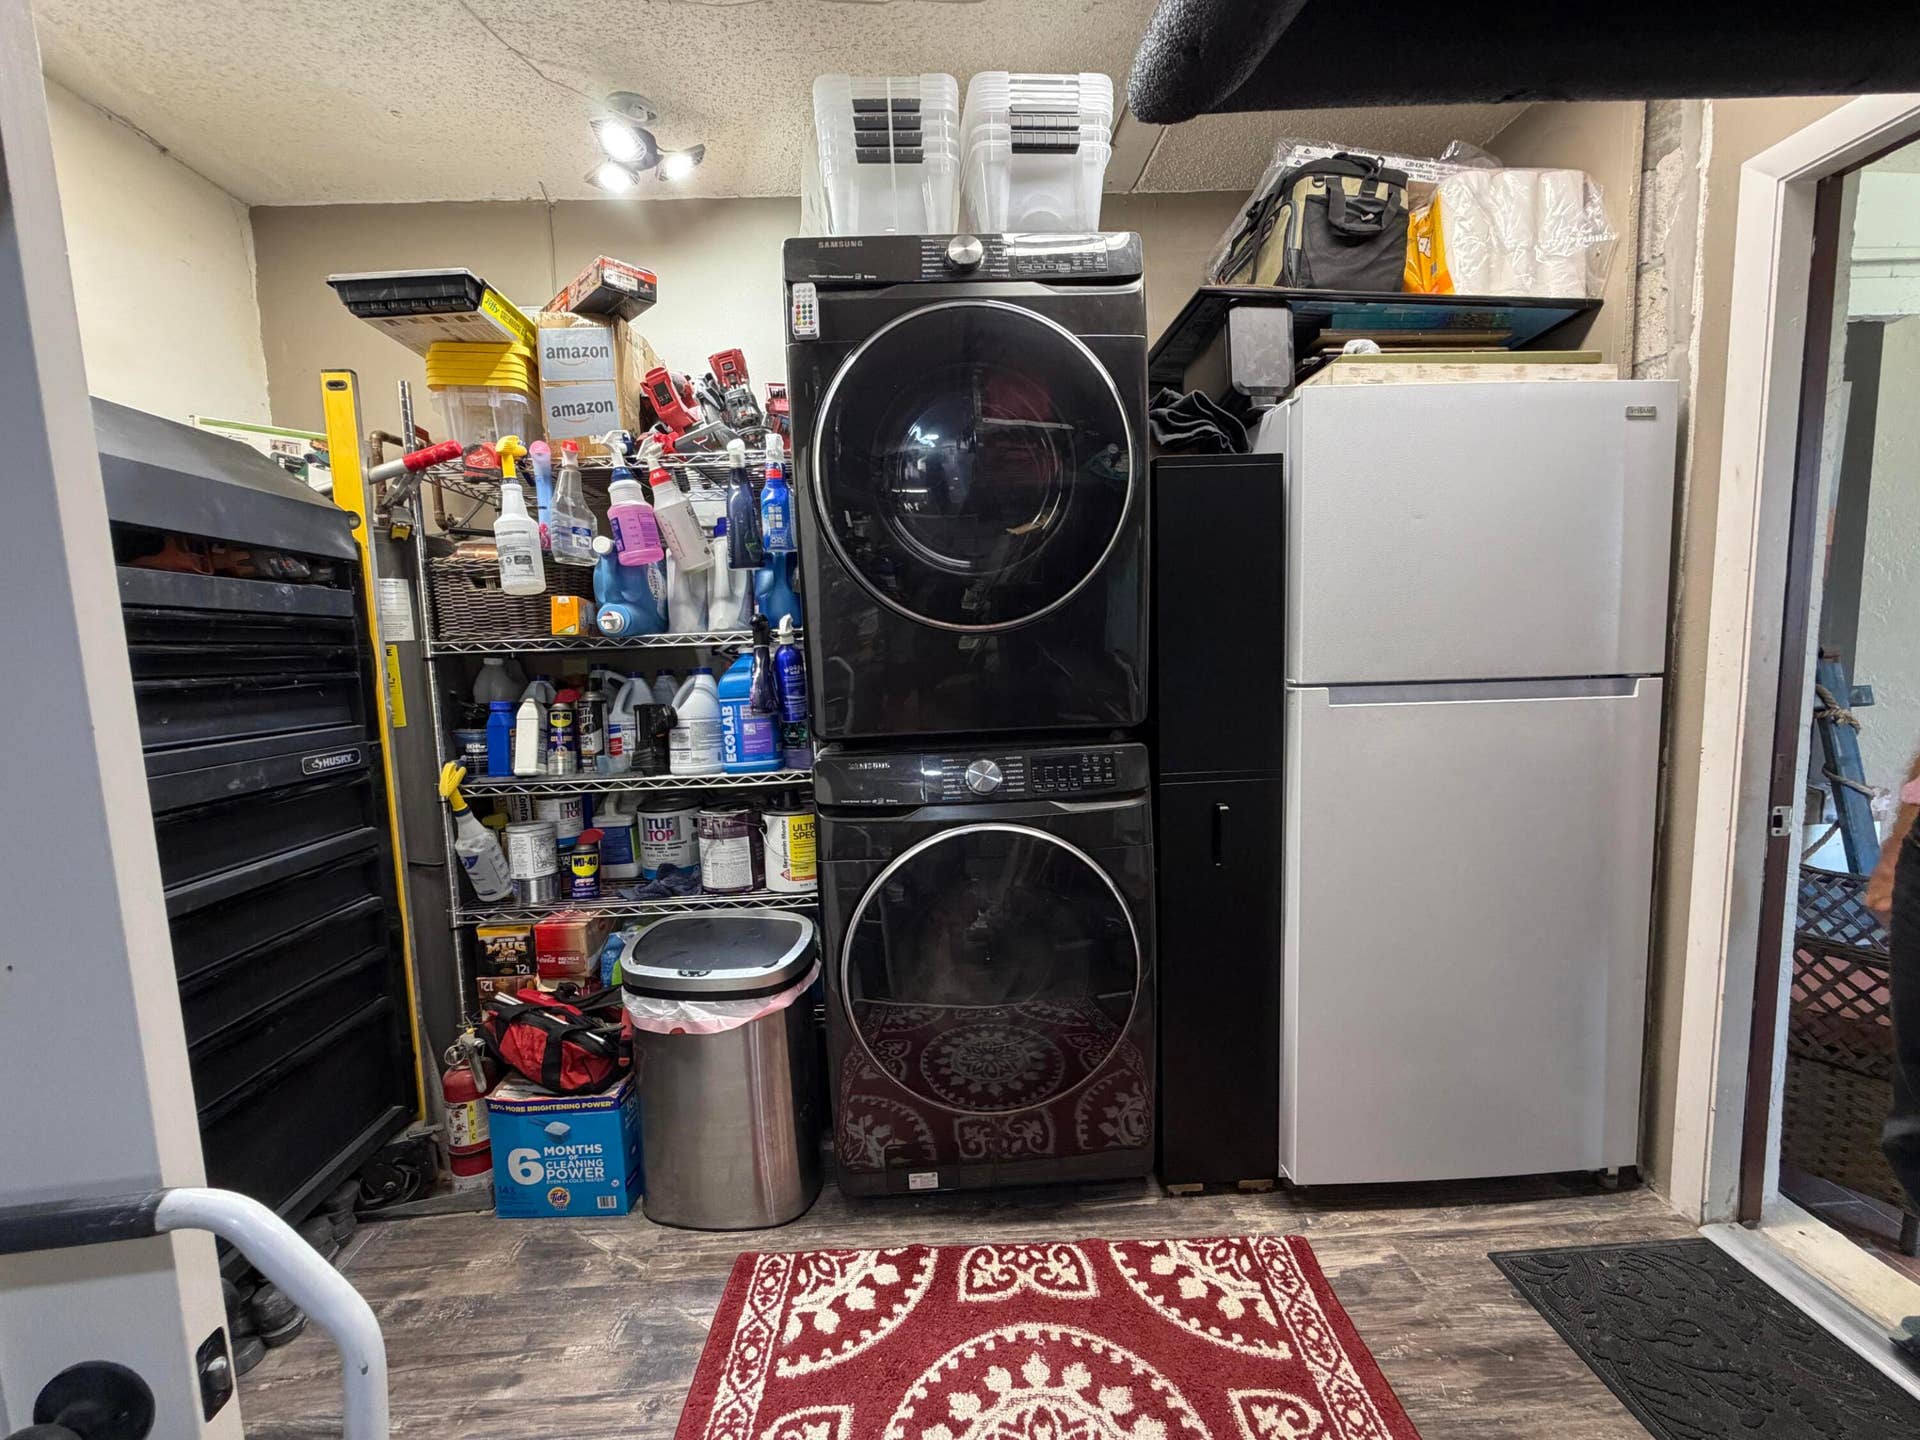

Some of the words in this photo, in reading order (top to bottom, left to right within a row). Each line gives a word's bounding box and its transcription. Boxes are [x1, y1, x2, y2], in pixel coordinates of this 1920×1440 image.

[818, 240, 863, 249] SAMSUNG
[546, 345, 609, 360] amazon
[551, 400, 614, 418] amazon
[552, 710, 571, 721] WD-40
[721, 705, 737, 763] ECOLAB
[322, 753, 352, 768] HUSKY
[647, 817, 673, 830] TUF
[792, 822, 816, 835] ULTR
[648, 829, 675, 842] TOP
[573, 856, 598, 867] WD-40
[486, 941, 527, 955] MUG
[505, 1105, 526, 1113] MORE
[527, 1103, 580, 1112] BRIGHTENING
[544, 1143, 602, 1156] MONTHS
[508, 1148, 544, 1185] 6
[545, 1159, 604, 1169] CLEANING
[546, 1167, 605, 1180] POWER
[551, 1191, 568, 1203] Tide
